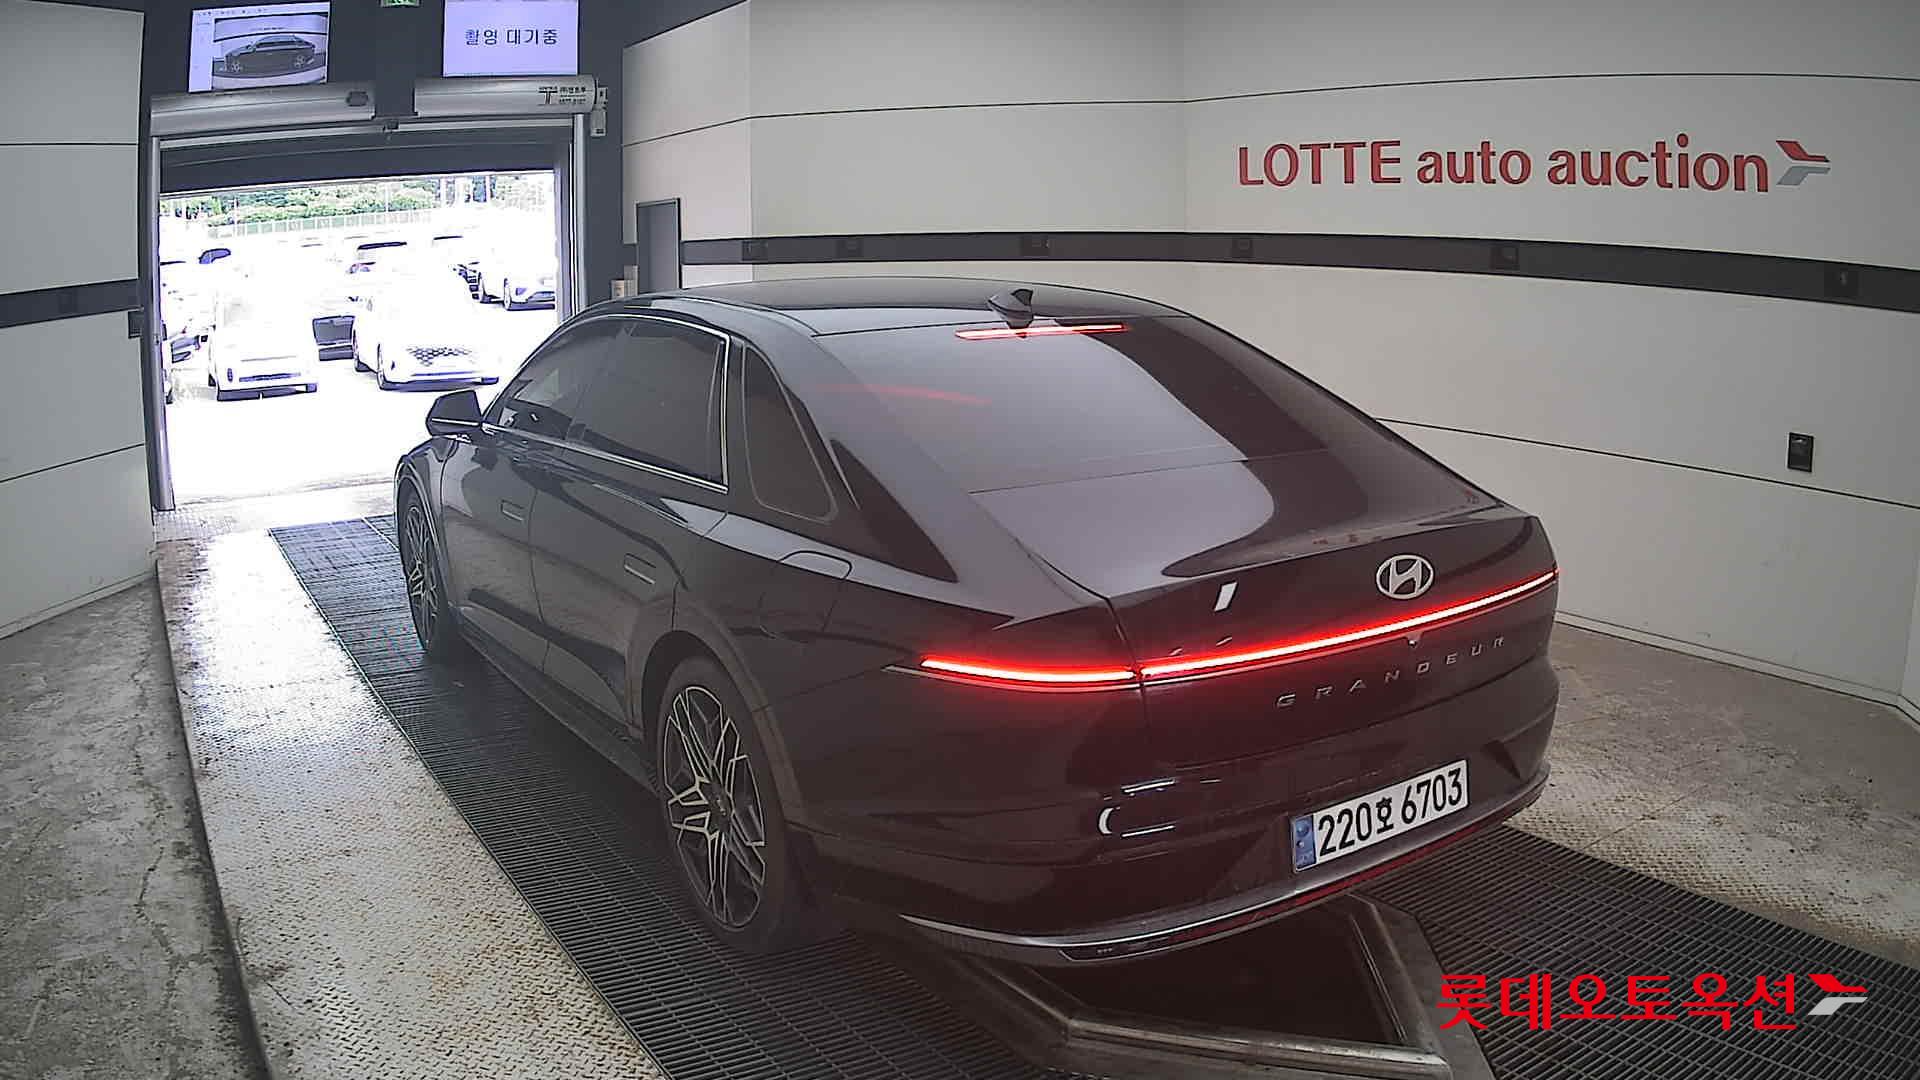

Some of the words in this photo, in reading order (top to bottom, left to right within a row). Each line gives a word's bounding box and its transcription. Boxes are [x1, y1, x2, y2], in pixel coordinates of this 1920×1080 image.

[506, 28, 558, 46] 대기중
[1239, 139, 1401, 187] LOTTE
[1416, 140, 1532, 186] auto
[1546, 133, 1769, 194] auction
[1276, 635, 1505, 709] GRANDEUR
[1318, 796, 1394, 858] 220호
[1400, 767, 1463, 825] 6703
